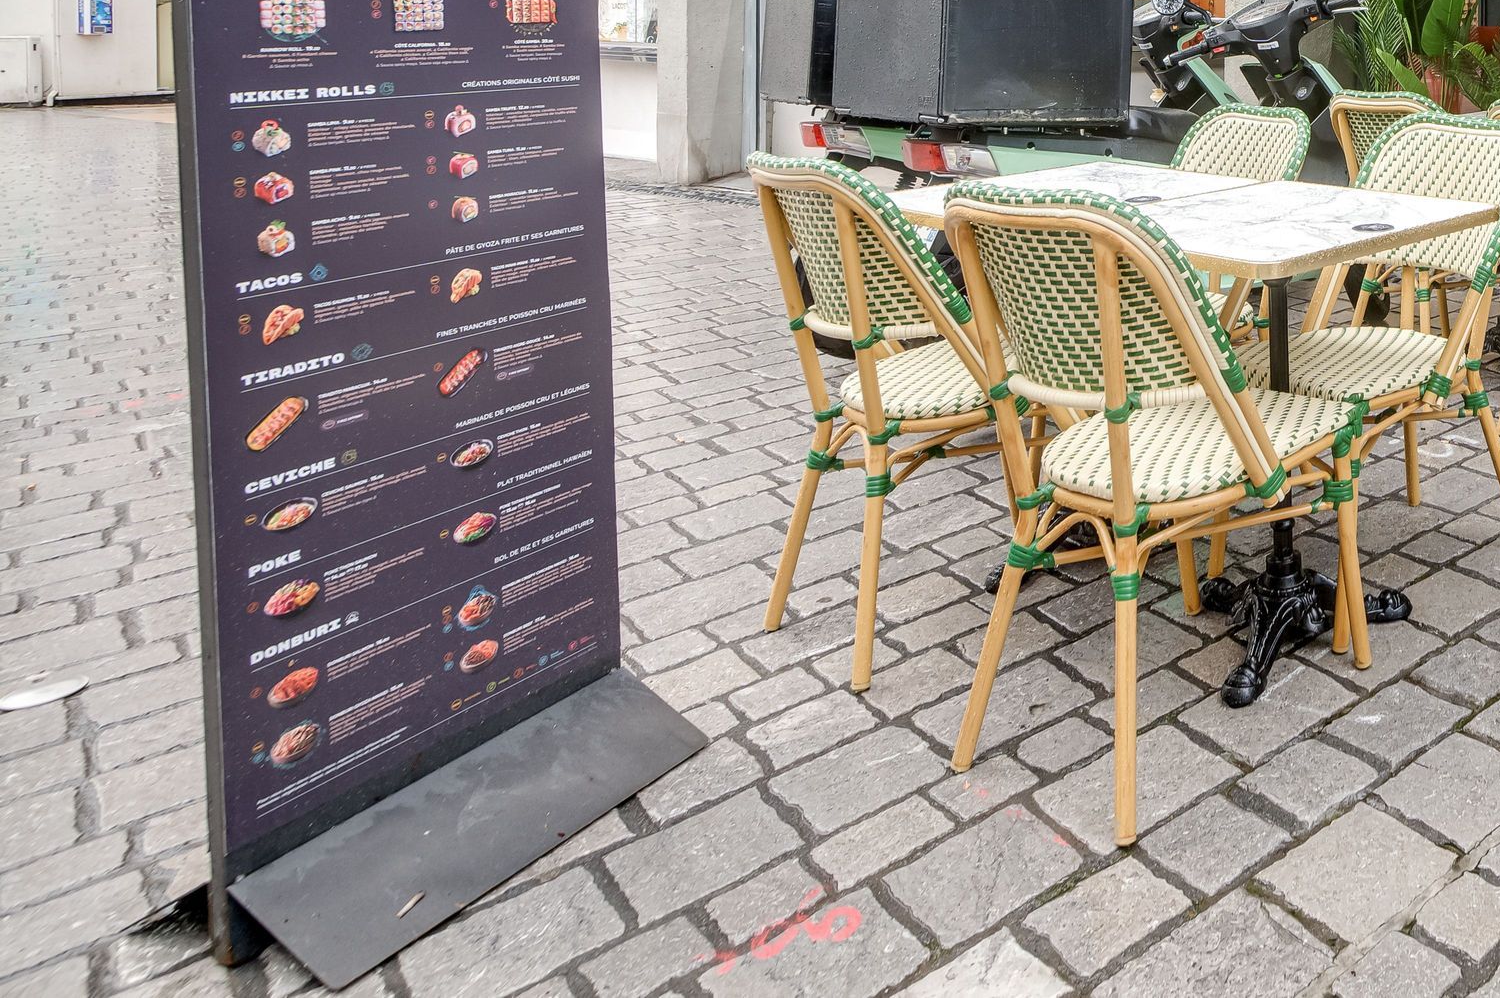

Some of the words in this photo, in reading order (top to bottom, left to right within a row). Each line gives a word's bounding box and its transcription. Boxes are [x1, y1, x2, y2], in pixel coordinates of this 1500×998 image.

[229, 88, 309, 103] NIKKEI
[316, 84, 376, 98] ROLLS
[461, 78, 501, 87] CRÉATIONS
[502, 77, 541, 85] ORIGINALES
[543, 76, 559, 84] CÔTÉ
[561, 75, 579, 83] SUSHI
[445, 245, 464, 255] PÂTE
[465, 243, 475, 251] DE
[476, 239, 499, 249] GYOZA
[501, 236, 519, 245] FRITE
[531, 231, 543, 239] SES
[544, 224, 584, 237] GARNITURES
[235, 271, 303, 294] TACOS
[436, 327, 458, 338] FINES
[459, 318, 497, 333] TRANCHES
[509, 309, 538, 321] POISSON
[540, 305, 553, 313] CRU
[554, 297, 586, 310] MARINÉES
[240, 352, 344, 387] TIRADITO
[455, 411, 493, 428] MARINADE
[494, 408, 504, 417] DE
[505, 399, 535, 413] POISSON
[536, 394, 550, 404] CRU
[551, 391, 559, 399] ET
[560, 382, 589, 396] LÉGUMES
[244, 456, 336, 495] CEVICHE
[496, 476, 514, 488] PLAT
[515, 460, 562, 482] TRADITIONNEL
[563, 448, 592, 464] HAWAÏEN
[494, 552, 508, 564] BOL
[509, 548, 518, 557] DE
[520, 543, 531, 553] RIZ
[532, 538, 540, 548] ET
[541, 533, 554, 544] SES
[554, 516, 594, 538] GARNITURES
[247, 548, 301, 578] POKE
[249, 617, 341, 666] DONBURI
